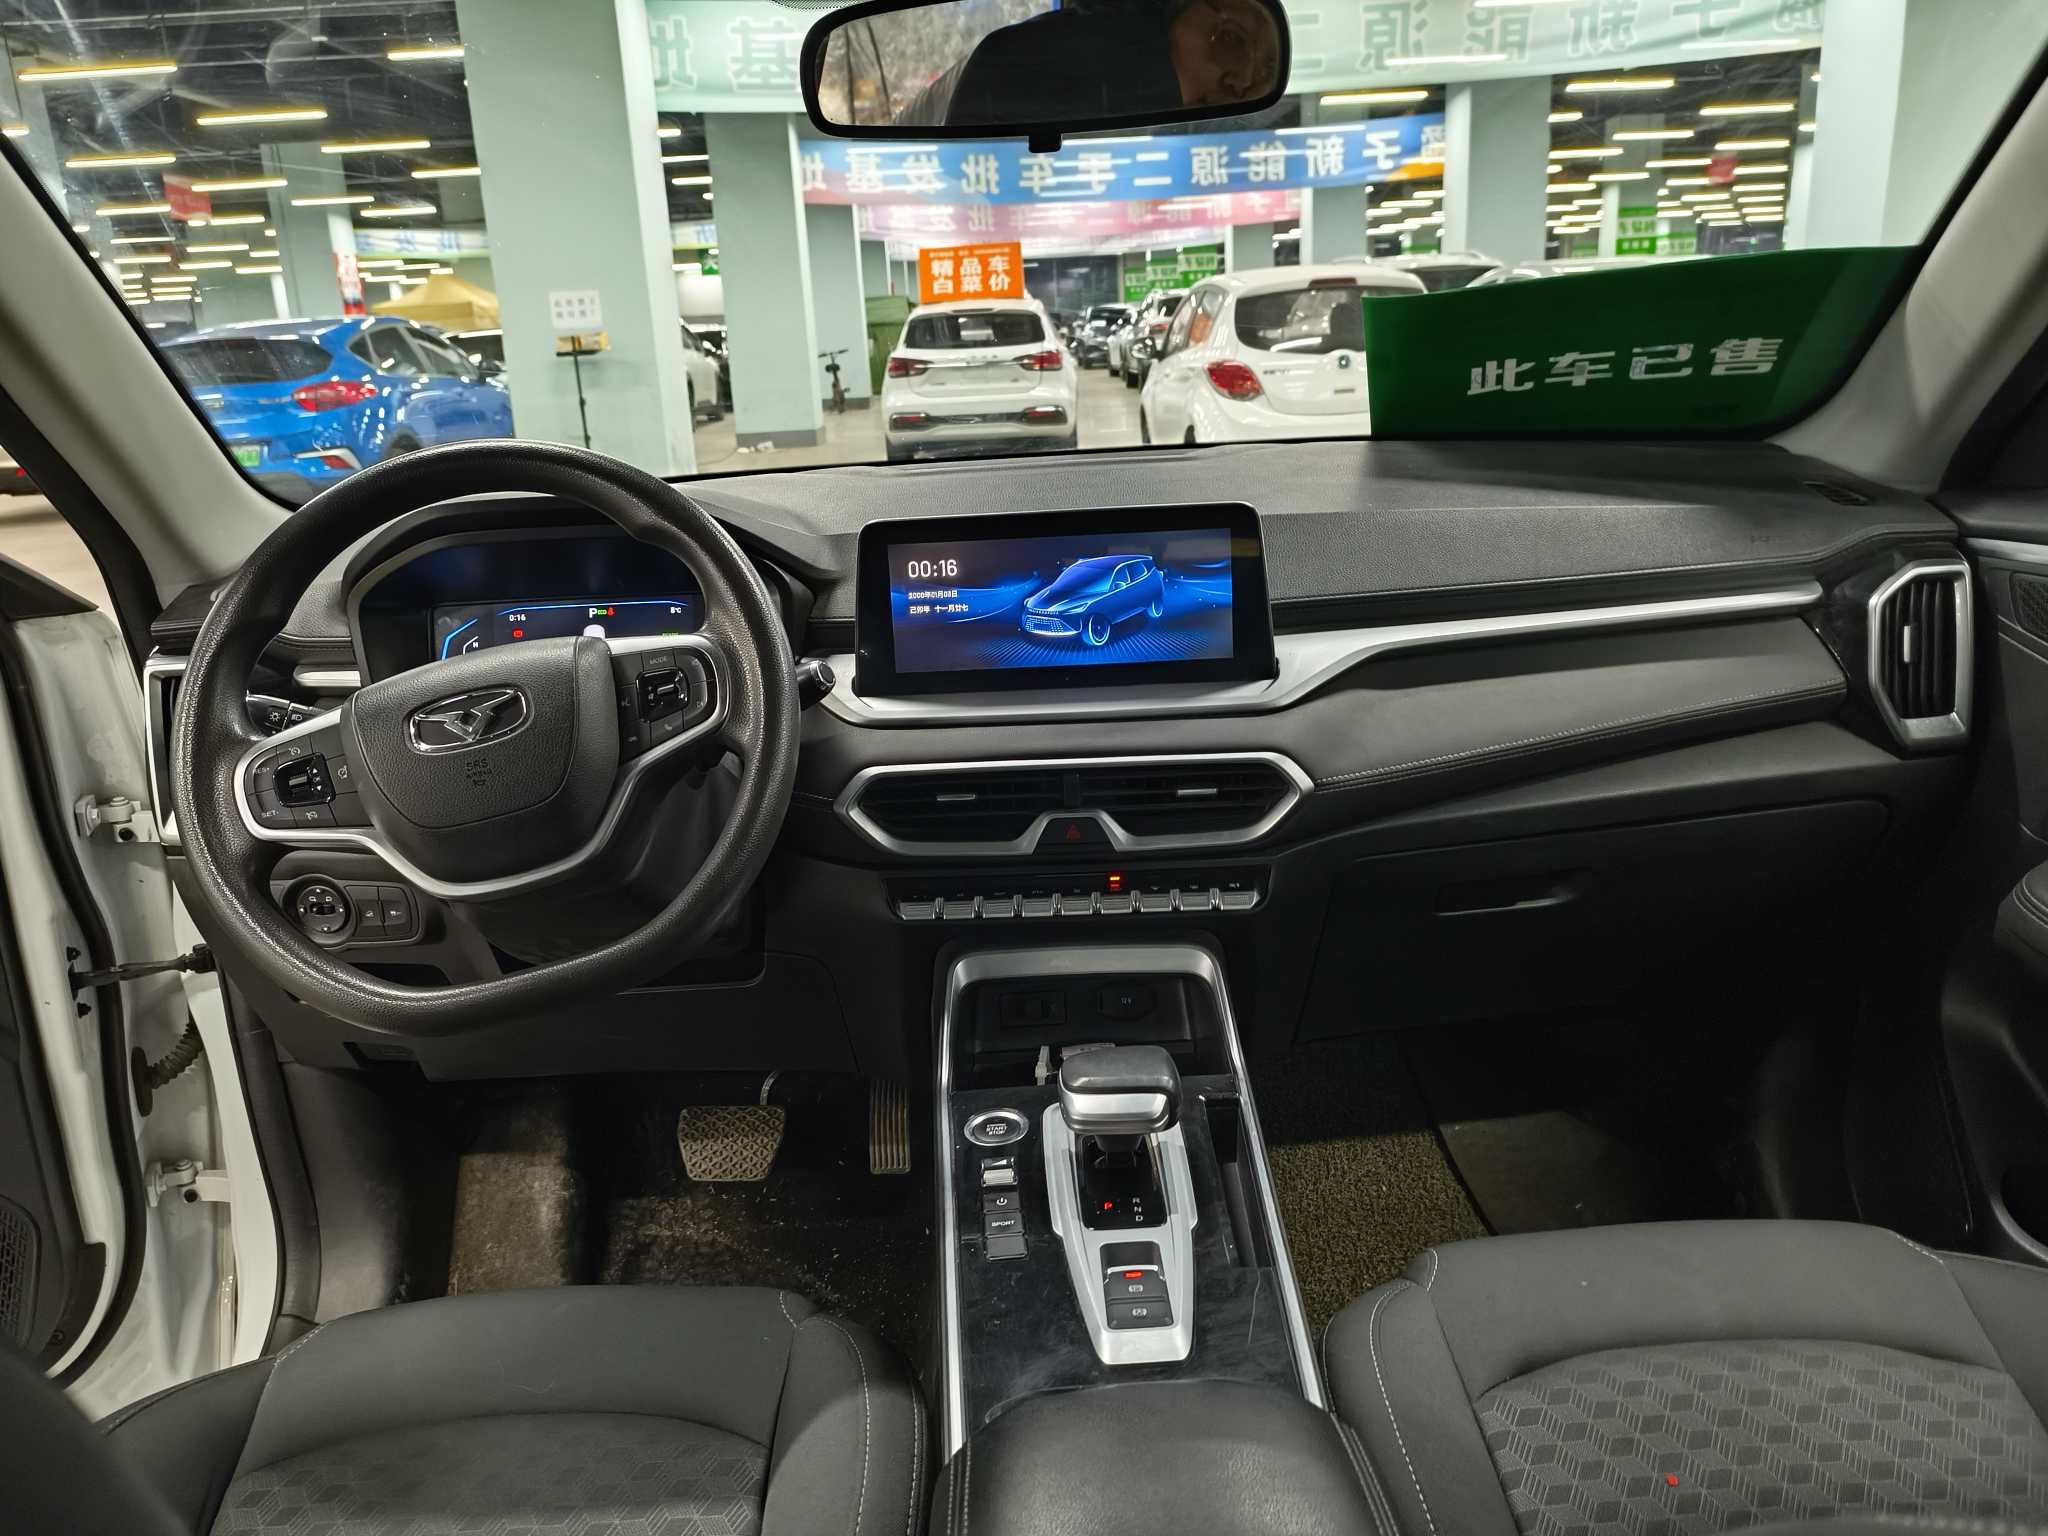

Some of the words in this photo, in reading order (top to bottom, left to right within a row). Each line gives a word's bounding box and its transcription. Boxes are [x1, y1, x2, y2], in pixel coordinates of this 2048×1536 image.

[931, 254, 1010, 278] 精品车
[932, 271, 1011, 296] 白菜价
[1467, 338, 1783, 395] 此车已售
[908, 559, 958, 578] 00:16
[589, 607, 597, 618] P
[991, 1219, 1015, 1227] SPORT
